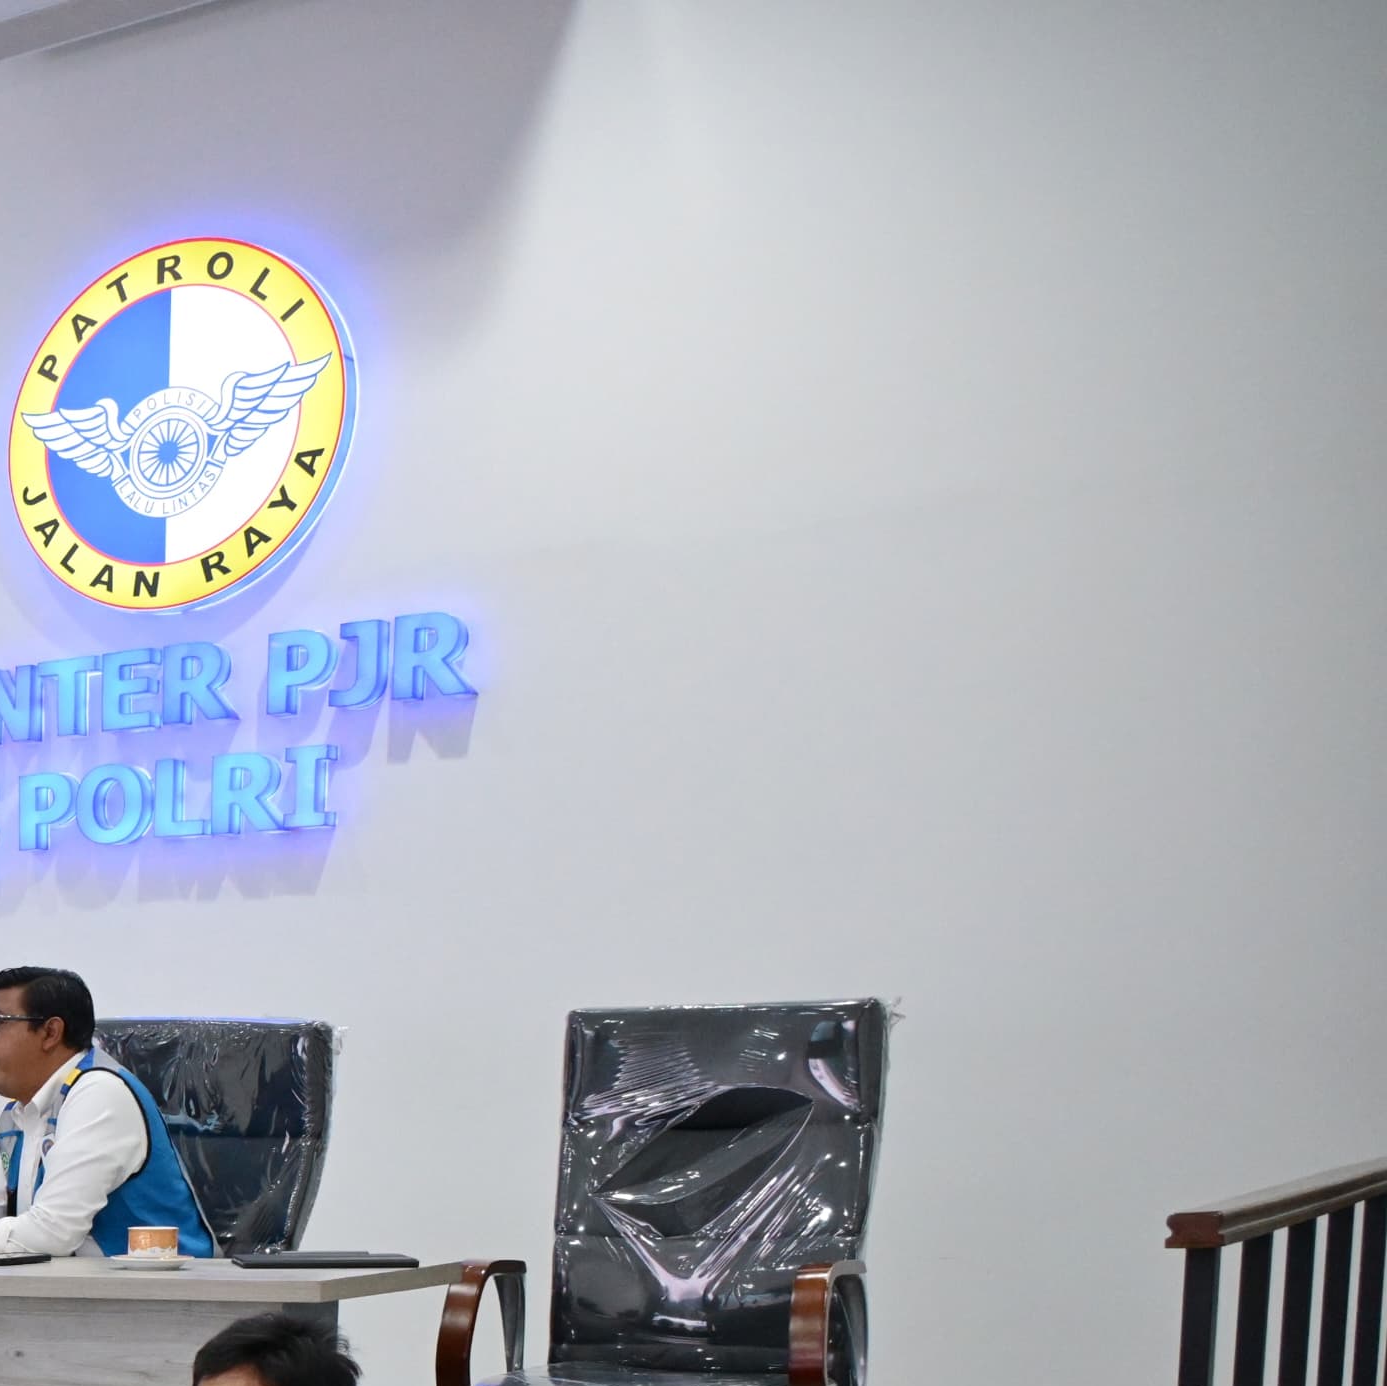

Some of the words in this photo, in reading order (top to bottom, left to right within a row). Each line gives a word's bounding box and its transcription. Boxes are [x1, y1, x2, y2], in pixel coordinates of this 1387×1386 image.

[37, 250, 305, 383] PATROLI
[132, 391, 208, 421] POLISI
[22, 486, 160, 598] JALAN
[200, 447, 325, 583] RAYA
[118, 481, 155, 515] LALU
[162, 469, 217, 515] LINTAS
[266, 611, 479, 717] PJR
[18, 744, 338, 852] POLRI
